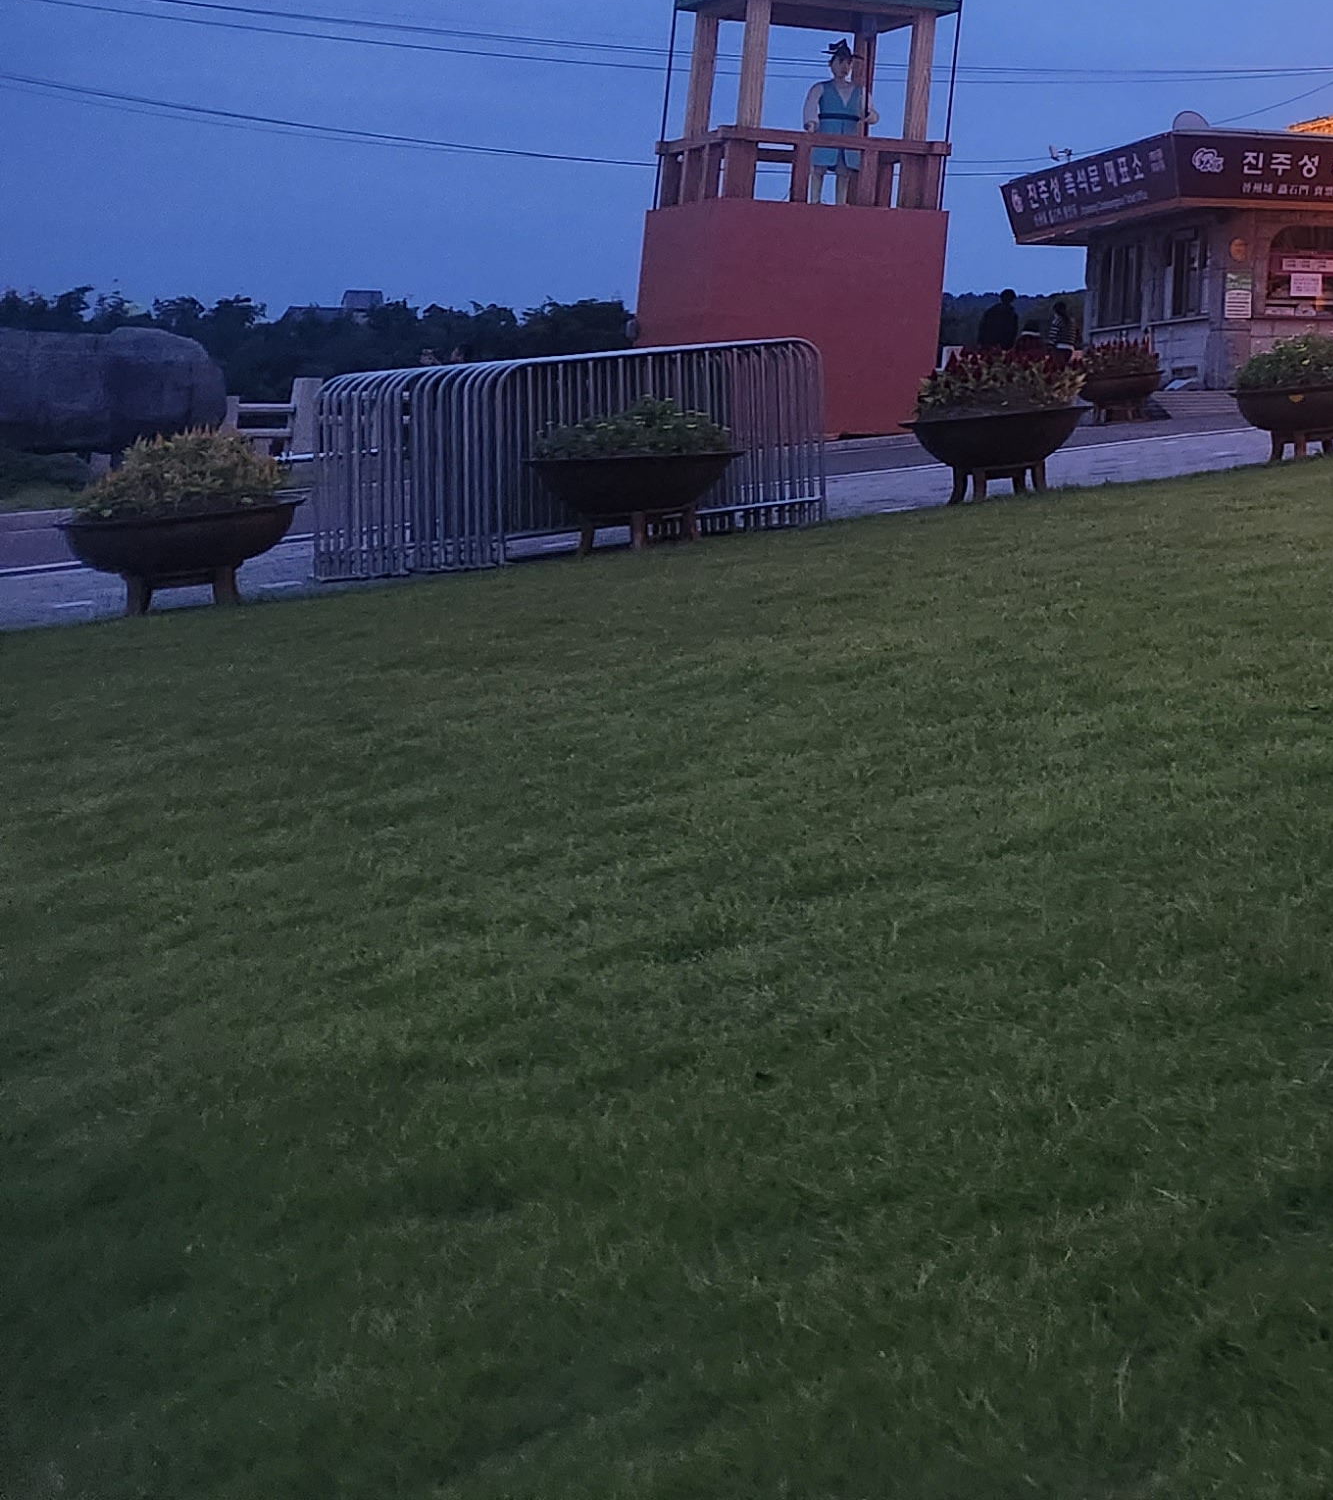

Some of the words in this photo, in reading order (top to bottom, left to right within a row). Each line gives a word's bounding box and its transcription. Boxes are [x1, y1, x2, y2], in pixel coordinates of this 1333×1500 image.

[1026, 176, 1062, 209] 진주성
[1063, 164, 1102, 197] 촉석문
[1103, 153, 1145, 187] 매표소
[1242, 152, 1320, 178] 진주성
